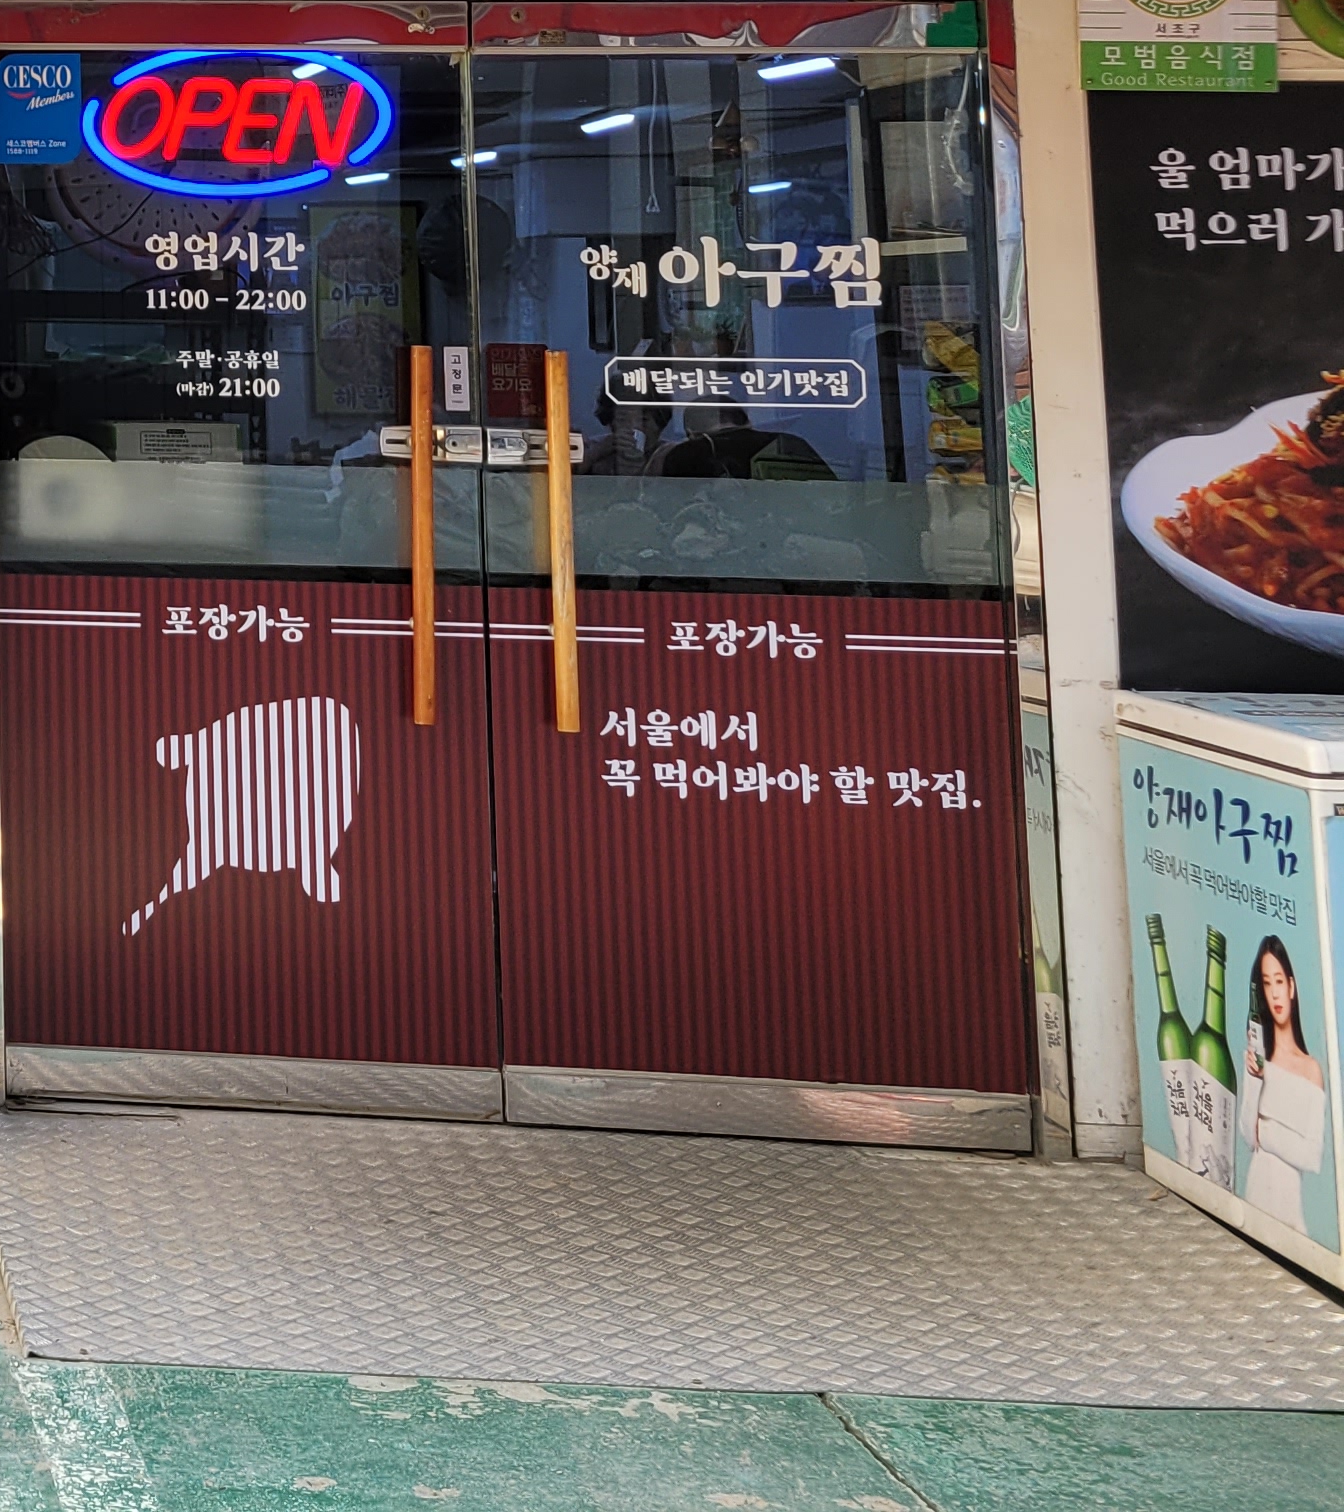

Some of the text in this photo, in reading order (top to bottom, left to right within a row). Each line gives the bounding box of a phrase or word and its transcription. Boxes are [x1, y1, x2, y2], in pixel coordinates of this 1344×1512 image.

[3, 65, 72, 88] CESCO
[1101, 72, 1255, 88] Good Restaurant
[26, 88, 75, 111] Members
[101, 76, 365, 166] OPEN
[48, 139, 67, 148] Zone
[1150, 147, 1196, 189] 울
[1155, 208, 1289, 251] 먹으러
[145, 232, 305, 272] 영업시간
[580, 244, 647, 298] 양재
[659, 236, 883, 309] 아구찜
[146, 289, 209, 311] 11:00
[236, 289, 306, 311] 22:00
[176, 377, 280, 398] (마감) 21:00
[622, 368, 849, 398] 배달되는 인기맛집
[163, 604, 310, 642] 포장가능
[667, 620, 824, 659] 포장가능
[600, 709, 758, 751] 서울에서
[602, 759, 982, 810] 꼭 먹어봐야 할 맛집.
